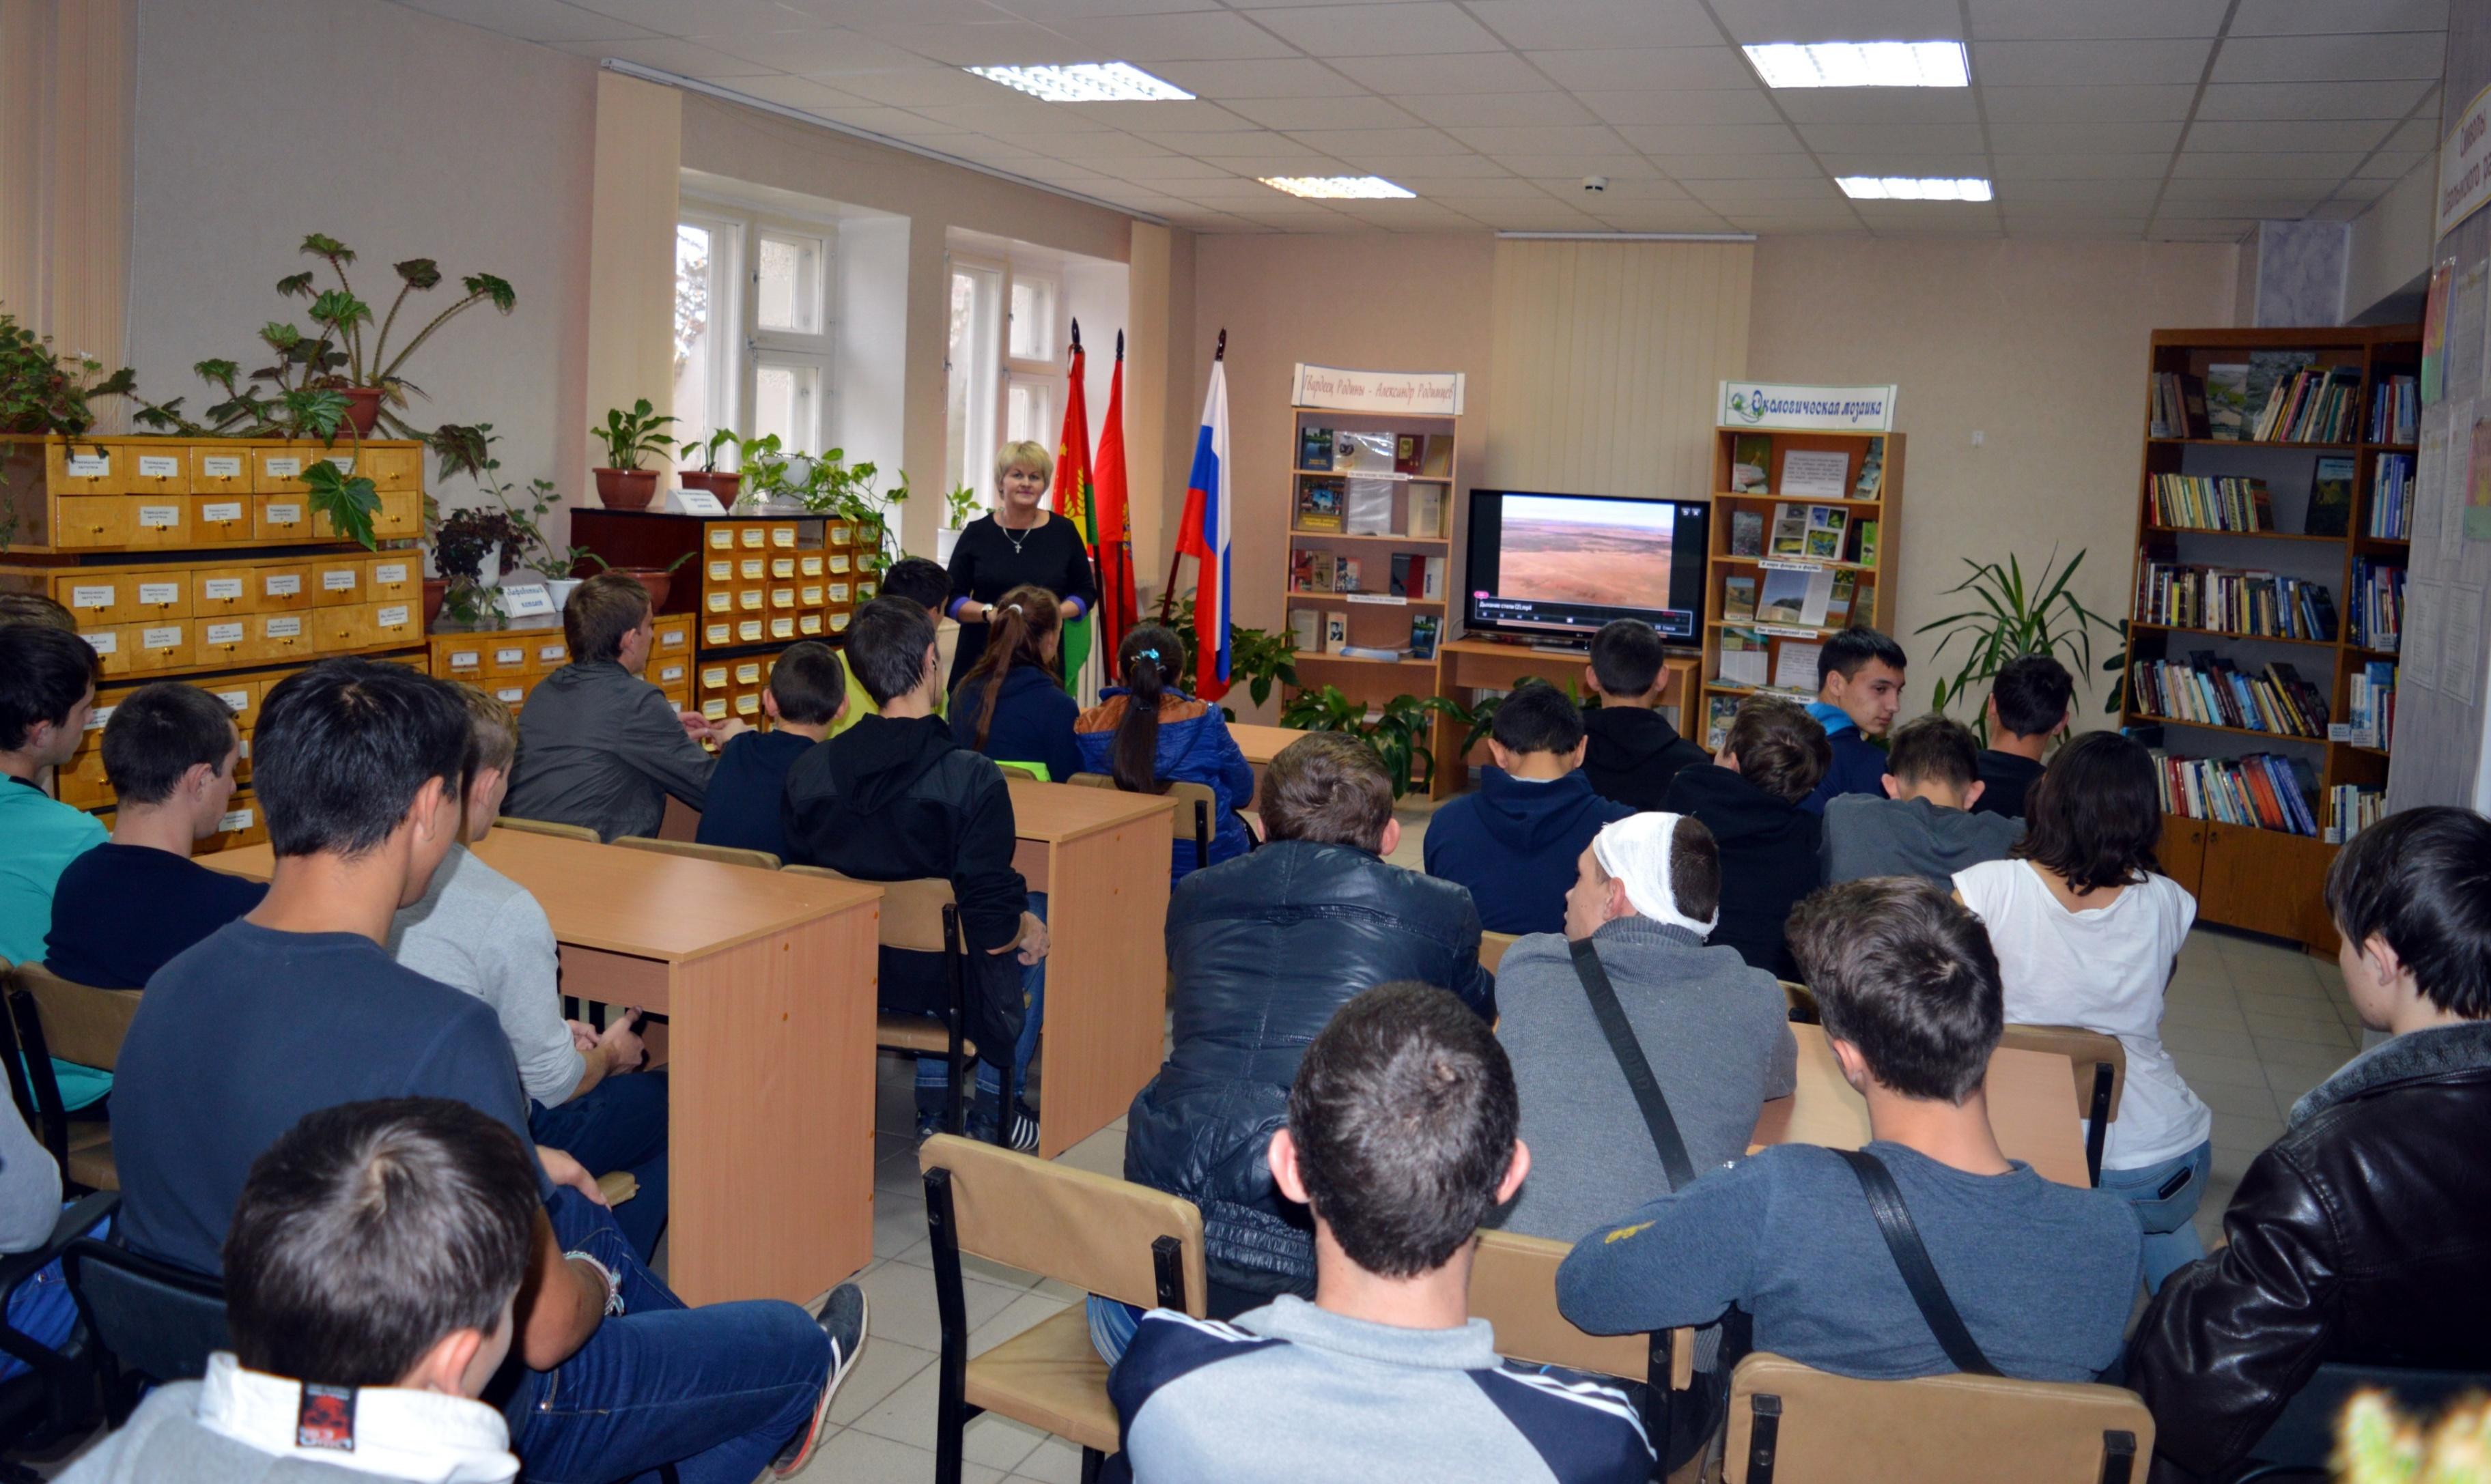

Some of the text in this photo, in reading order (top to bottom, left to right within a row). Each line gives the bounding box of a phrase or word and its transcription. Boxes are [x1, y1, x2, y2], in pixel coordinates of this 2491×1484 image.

[1303, 375, 1334, 399] Гвардеец
[1337, 378, 1365, 397] Родины
[1375, 382, 1415, 405] Александр
[1418, 382, 1454, 403] Родимцев
[1751, 389, 1882, 423] Экологическая мозаика
